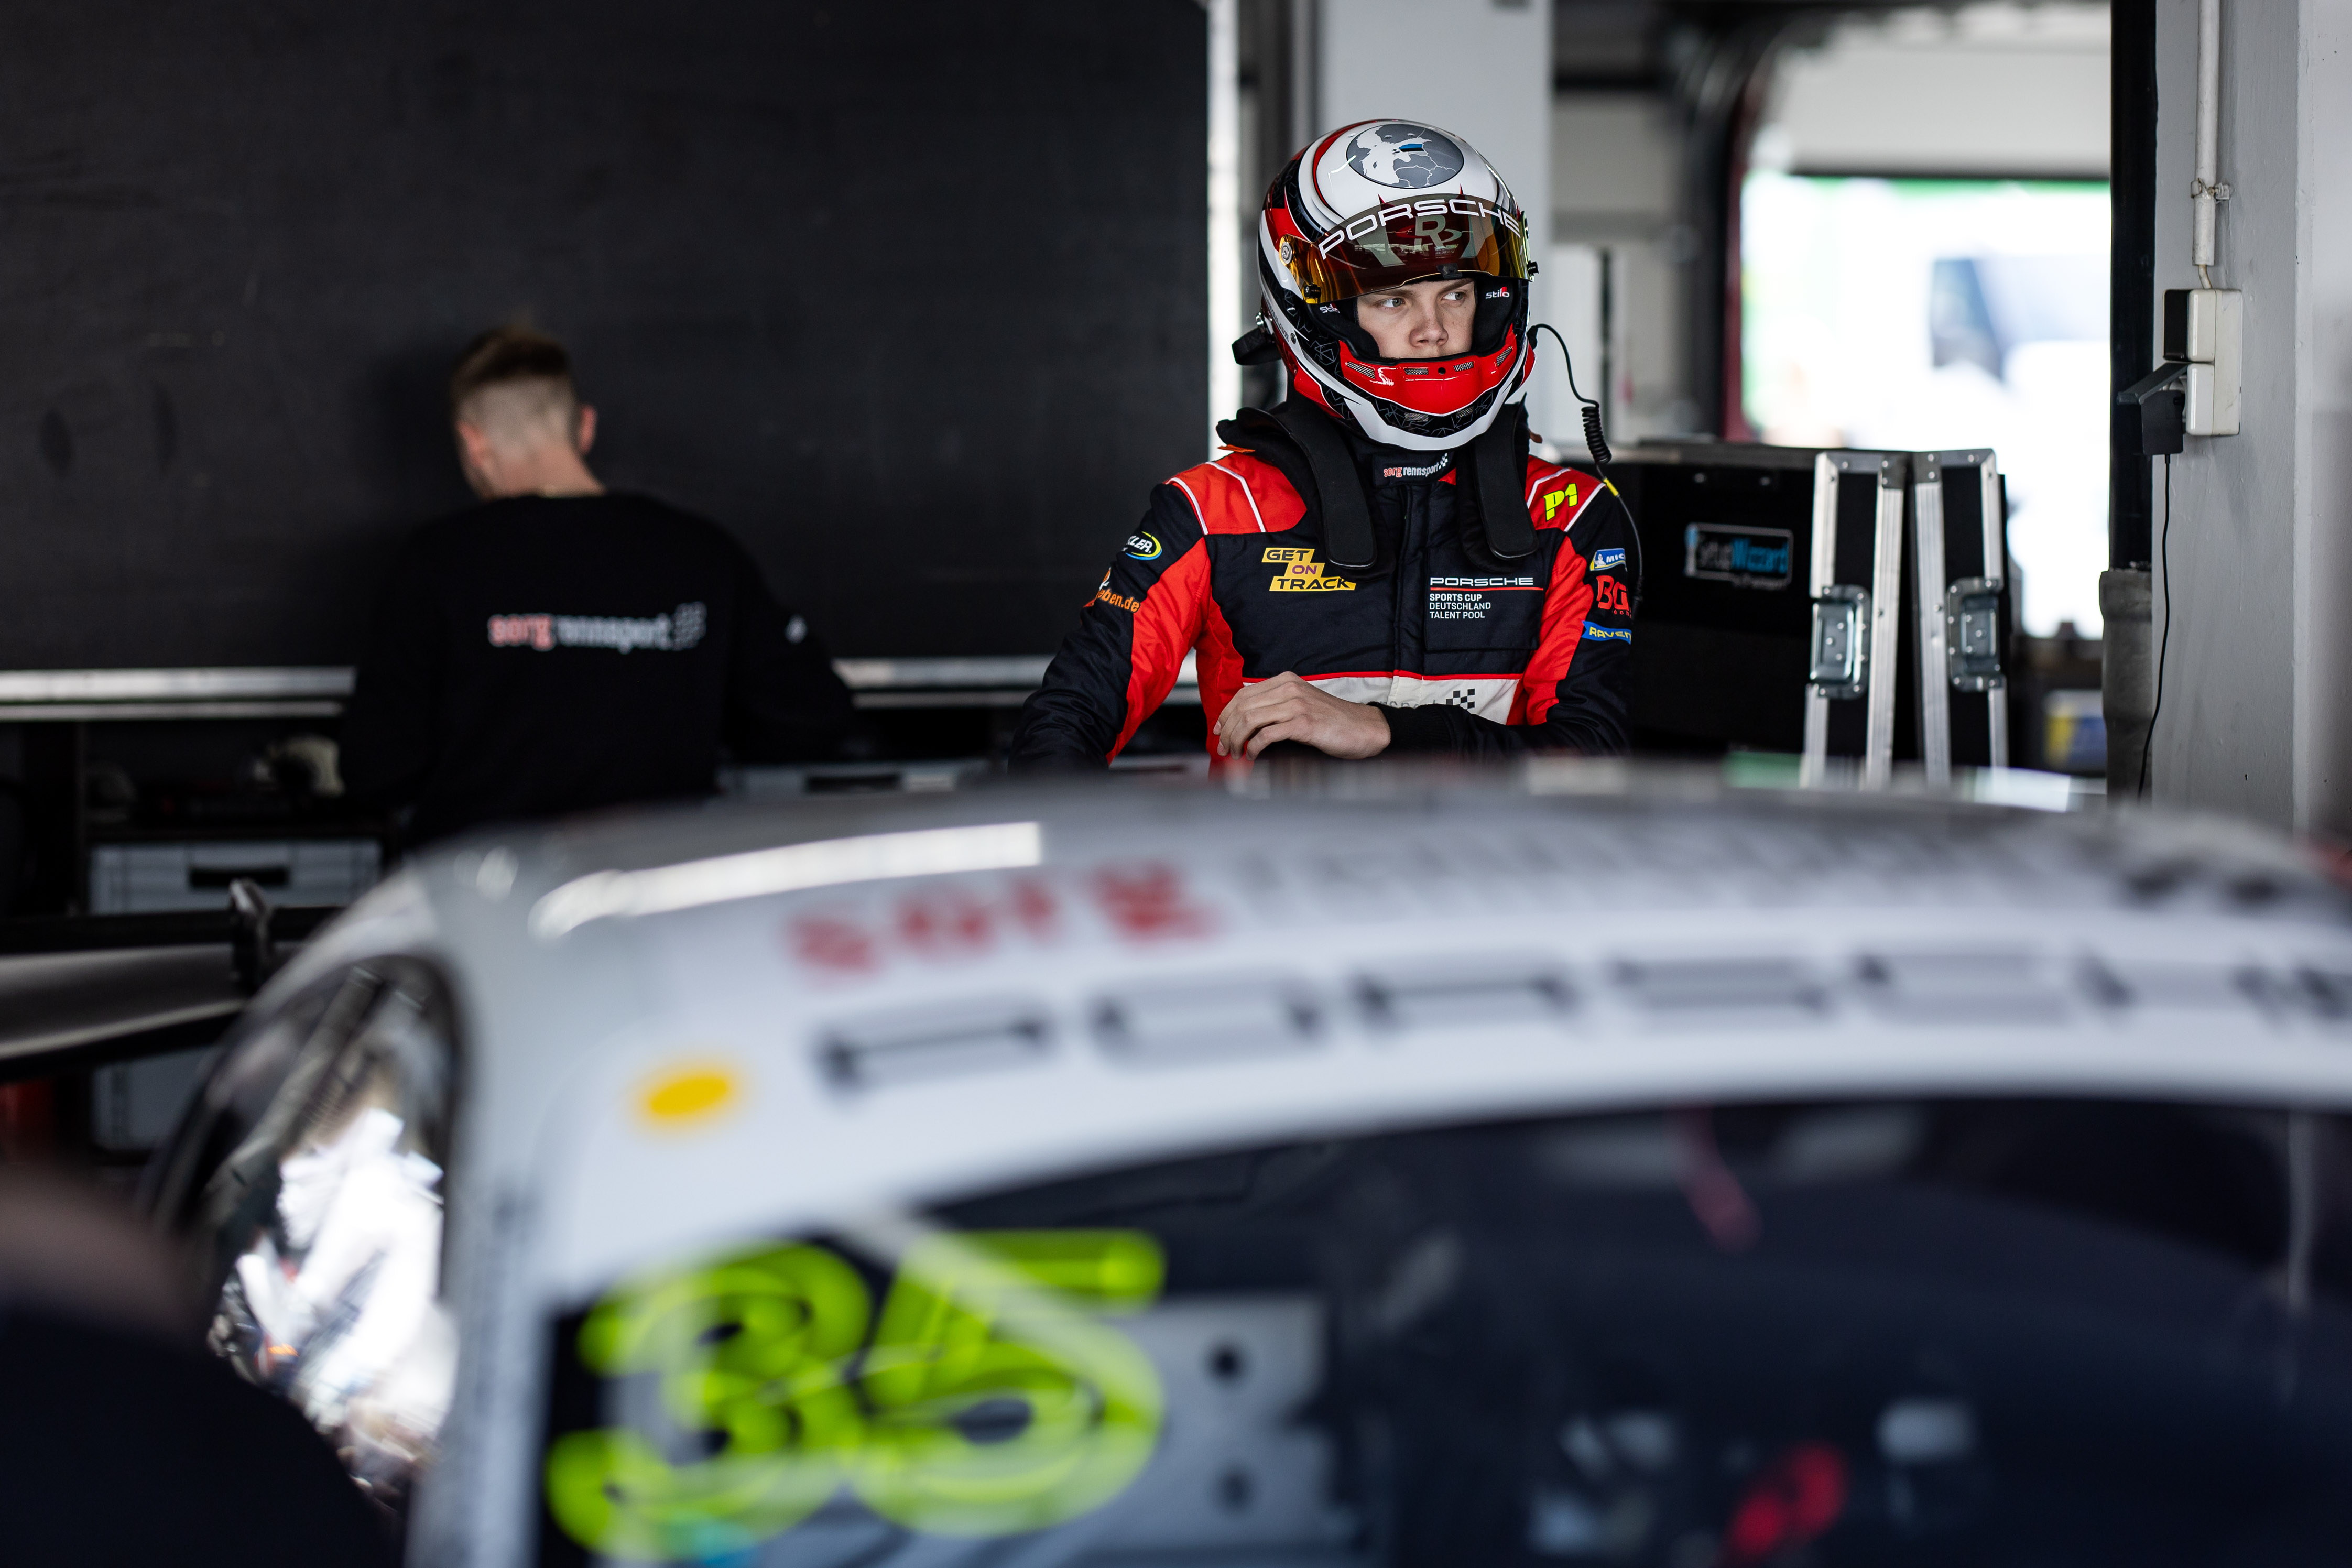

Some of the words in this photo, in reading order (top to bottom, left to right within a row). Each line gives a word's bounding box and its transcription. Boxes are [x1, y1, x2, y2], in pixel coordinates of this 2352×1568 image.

[1317, 198, 1521, 260] PORSCHE
[1485, 288, 1510, 299] stilo
[1542, 483, 1578, 522] P1
[1266, 549, 1310, 561] GET
[1292, 565, 1317, 574] ON
[1277, 578, 1351, 590] TRACK
[1430, 577, 1533, 586] PORSCHE
[548, 1229, 1168, 1561] 35
